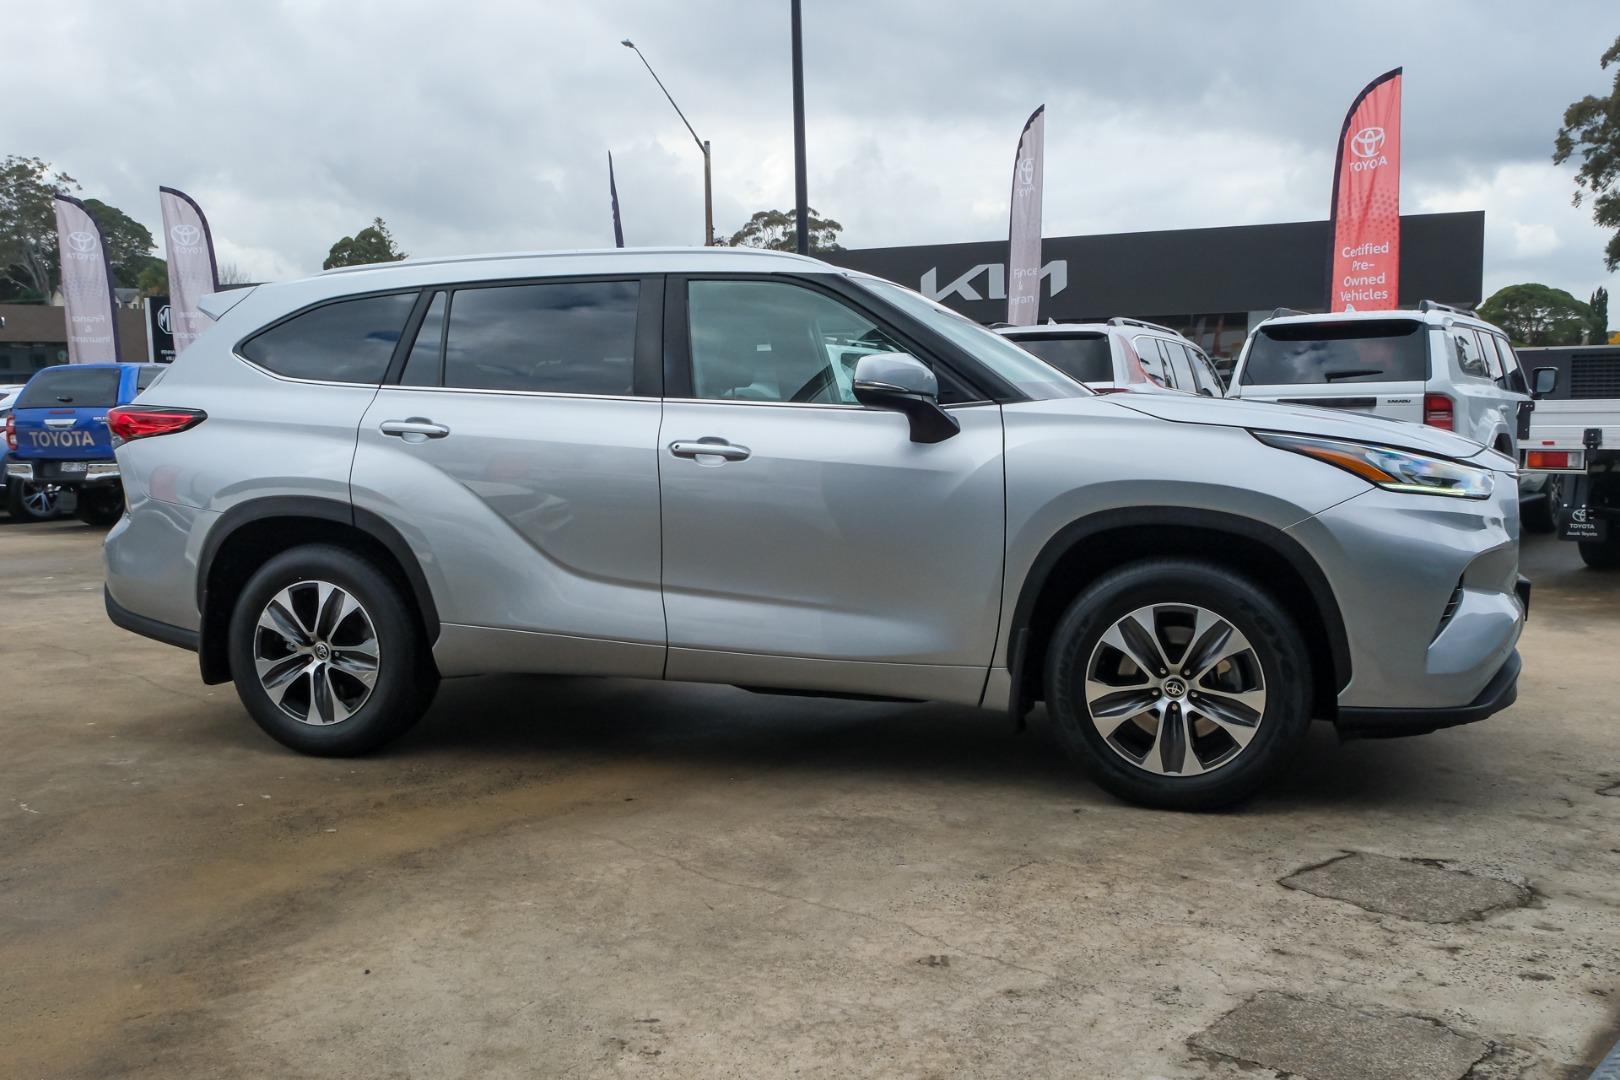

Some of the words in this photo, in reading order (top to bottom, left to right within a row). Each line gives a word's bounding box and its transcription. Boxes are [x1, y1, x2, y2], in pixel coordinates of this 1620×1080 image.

[1350, 156, 1388, 171] TOYOA
[1342, 242, 1389, 258] Certified
[1352, 260, 1375, 271] Pre-
[1344, 272, 1385, 287] Owned
[1340, 289, 1389, 301] Vehicles
[29, 431, 96, 447] TOYOTA
